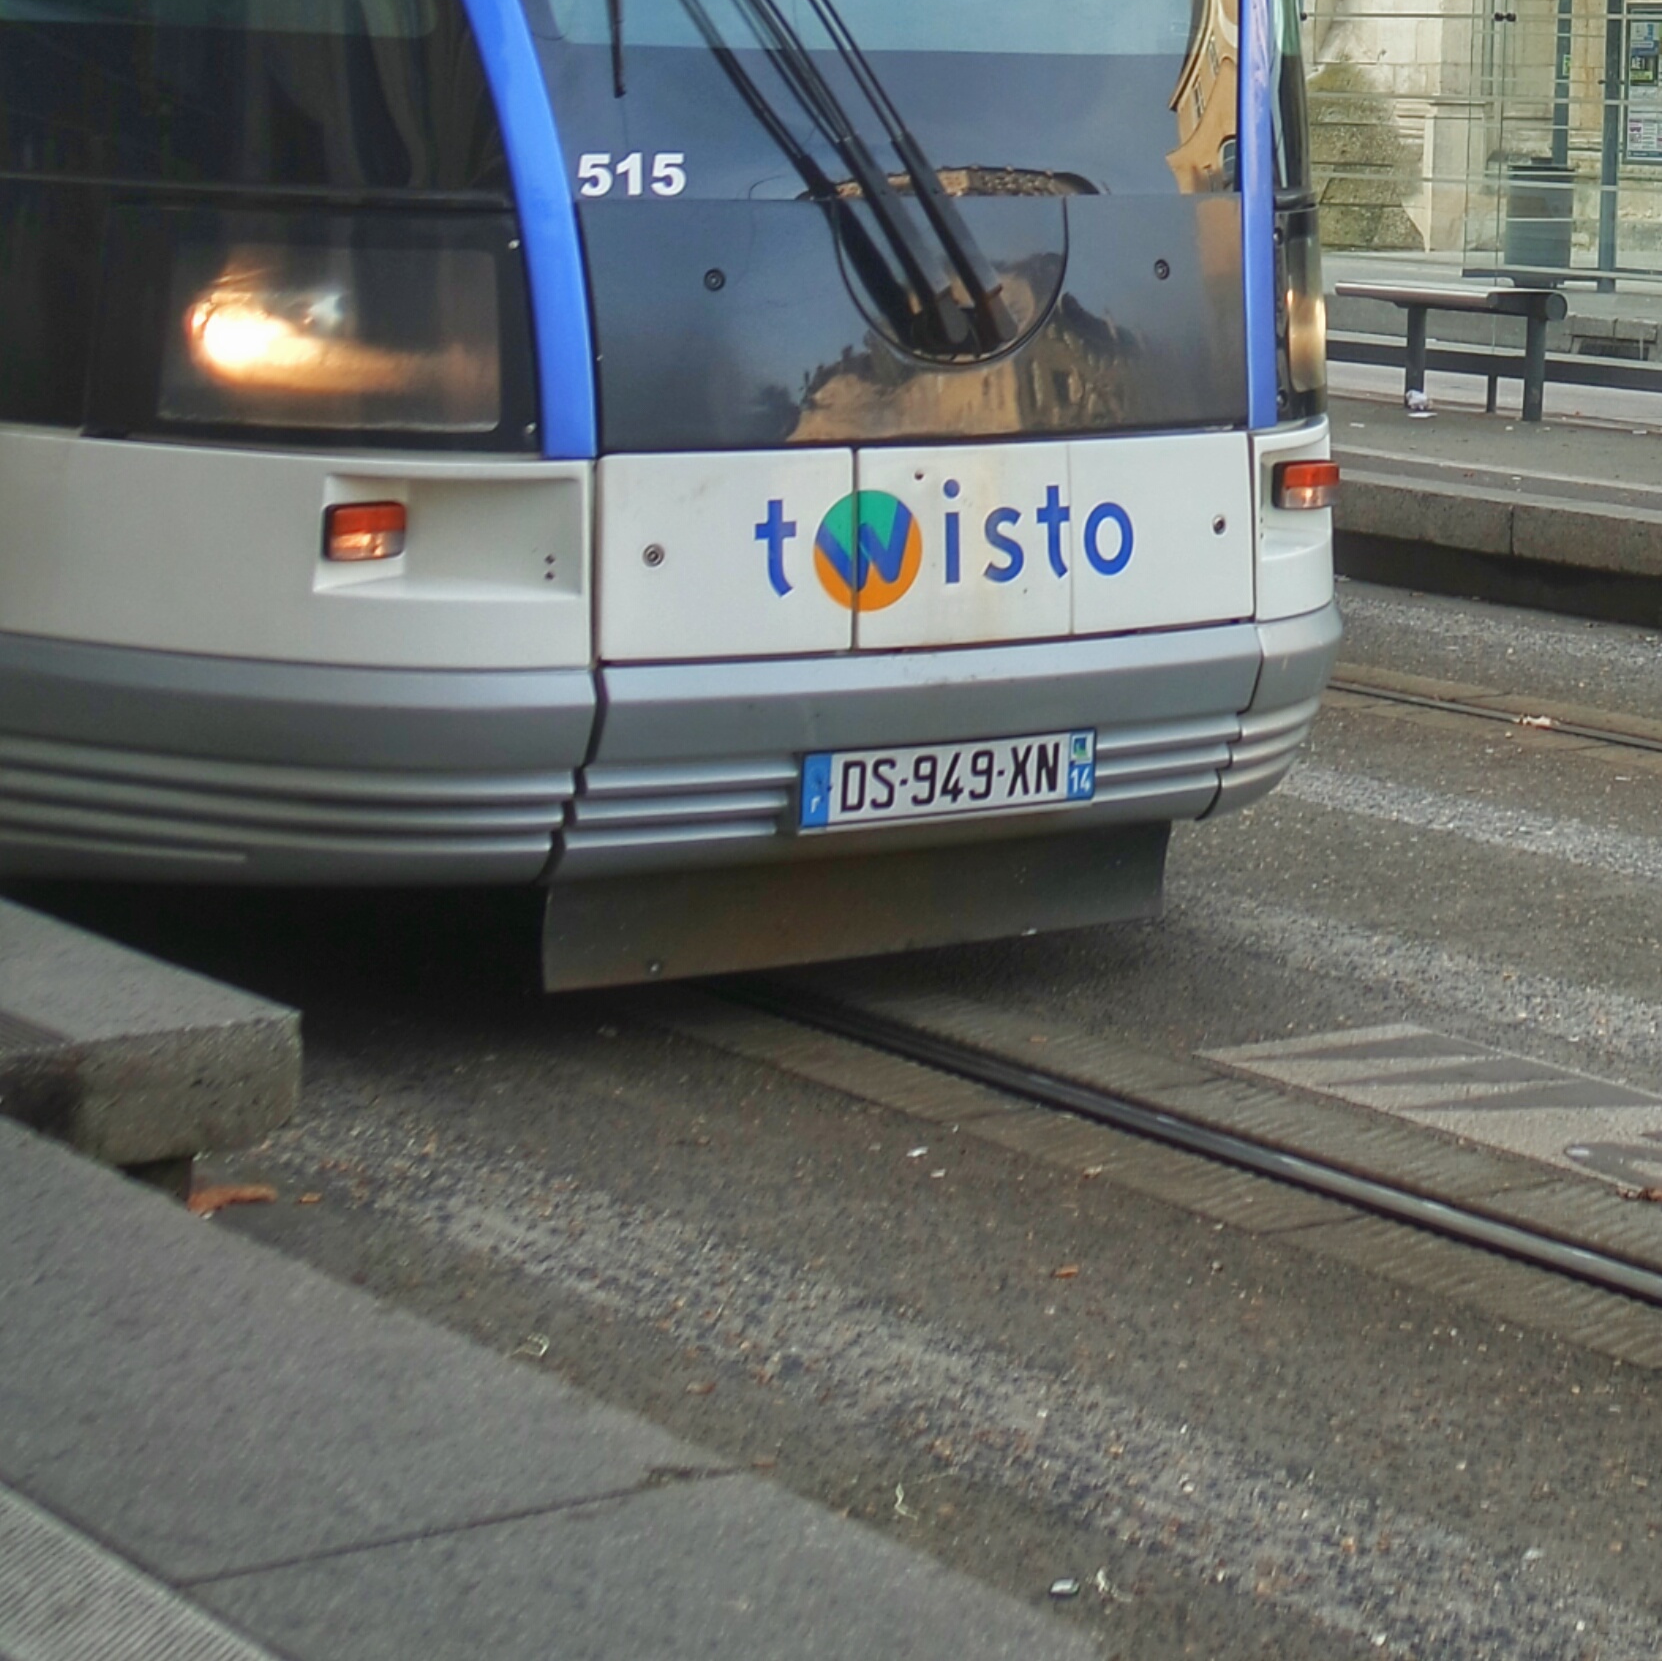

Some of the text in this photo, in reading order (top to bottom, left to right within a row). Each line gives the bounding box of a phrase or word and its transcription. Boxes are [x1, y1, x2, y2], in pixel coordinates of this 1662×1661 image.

[577, 152, 687, 197] 515
[754, 479, 1134, 607] twisto
[1070, 766, 1091, 794] 14
